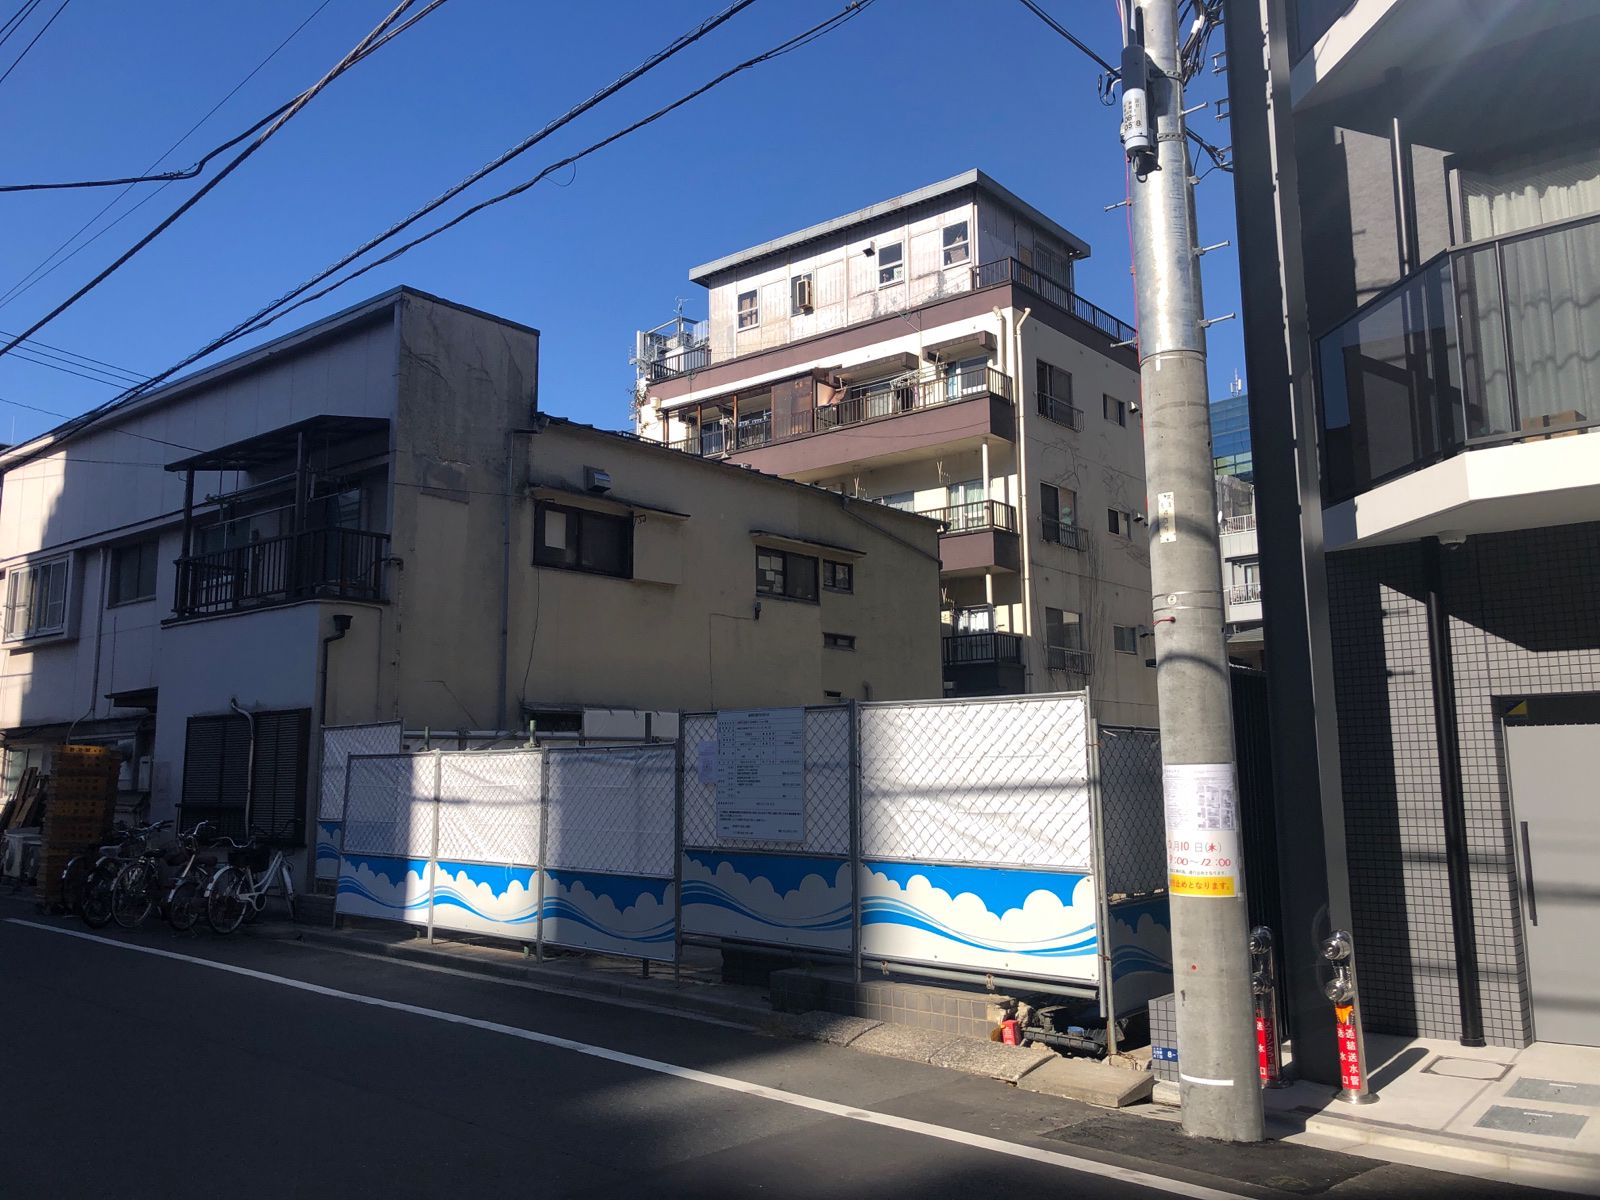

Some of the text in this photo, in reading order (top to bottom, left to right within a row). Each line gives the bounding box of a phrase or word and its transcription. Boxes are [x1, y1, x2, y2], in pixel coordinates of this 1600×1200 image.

[1256, 1020, 1266, 1075] 送水口
[1337, 1027, 1349, 1085] 送水口
[1345, 1027, 1360, 1086] 連結送水管
